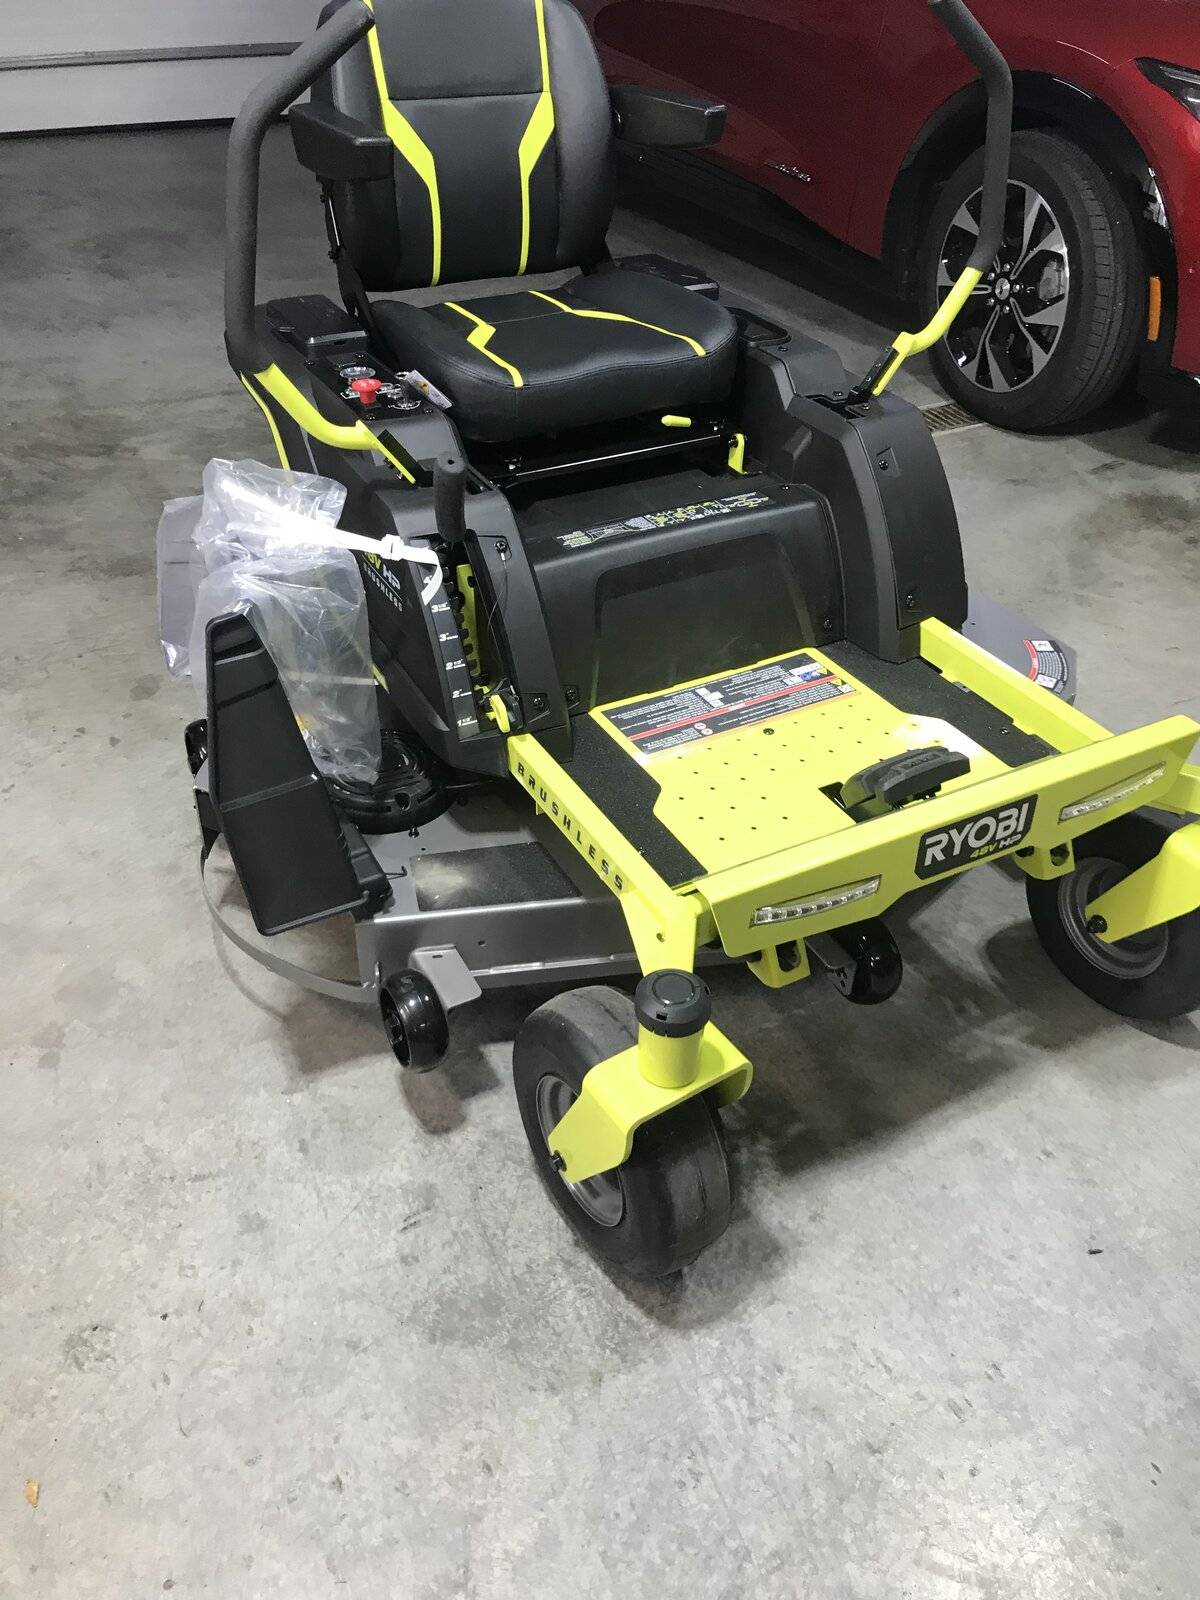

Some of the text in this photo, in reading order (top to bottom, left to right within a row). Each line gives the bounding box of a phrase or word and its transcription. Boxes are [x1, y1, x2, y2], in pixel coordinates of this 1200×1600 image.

[363, 562, 403, 612] BRUSHLESS
[383, 563, 401, 590] HP
[517, 761, 624, 891] BRUSHLESS
[923, 802, 1030, 867] RYOBI
[969, 834, 1022, 859] 48V HP
